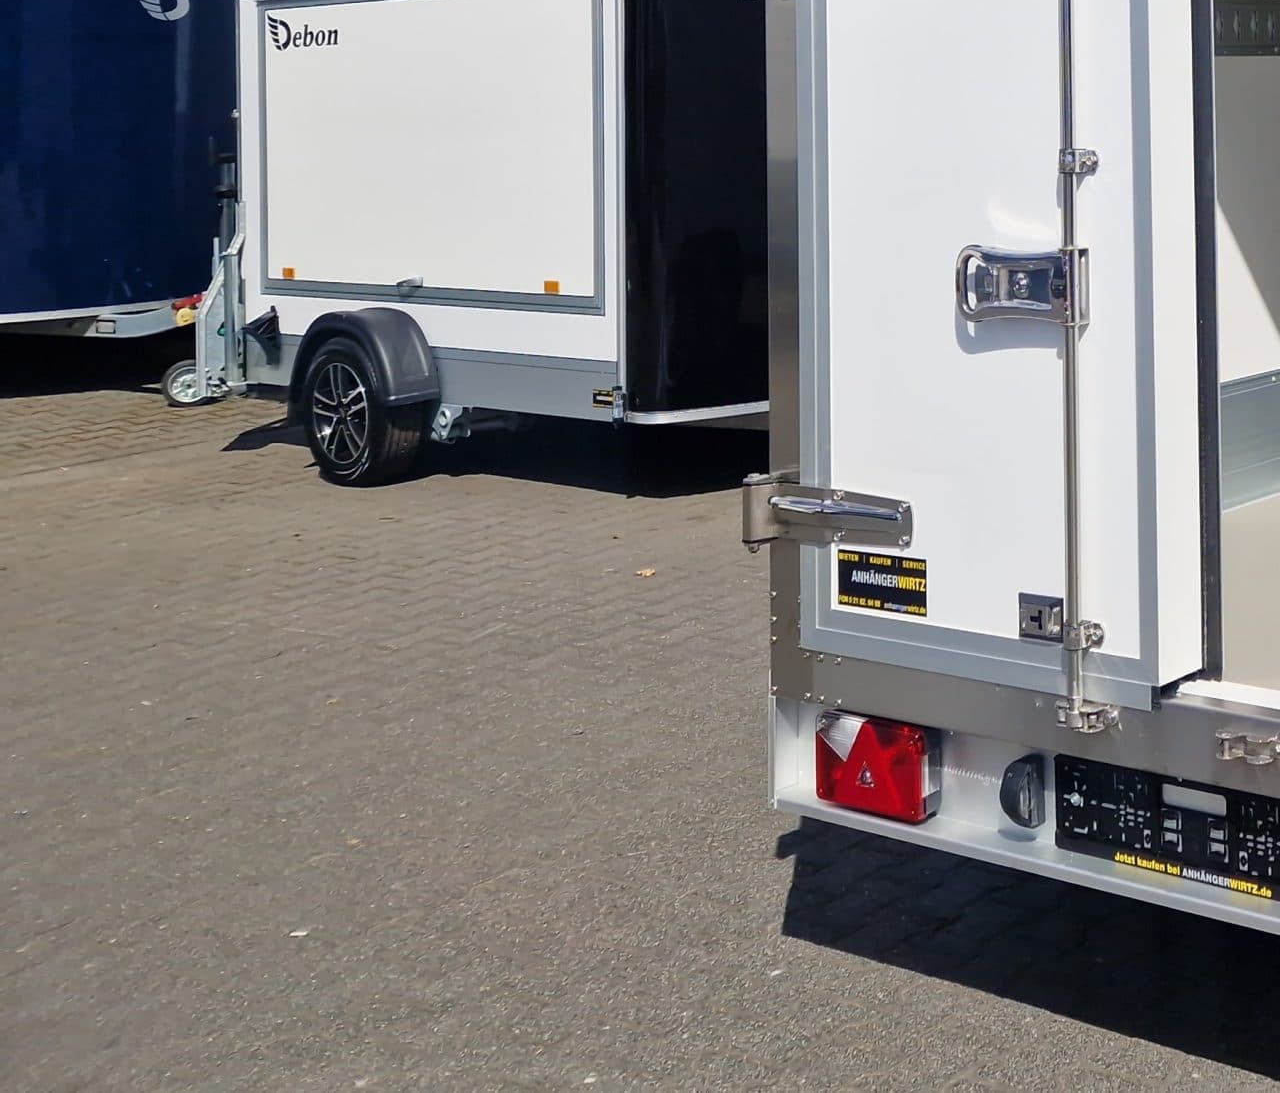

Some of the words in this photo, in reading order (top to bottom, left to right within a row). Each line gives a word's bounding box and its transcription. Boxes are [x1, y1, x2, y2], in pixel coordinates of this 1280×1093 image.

[266, 12, 339, 51] Debon
[869, 556, 892, 566] KAUFEN
[902, 560, 926, 571] SERVICE
[851, 569, 926, 592] ANHÄNGERWIRTZ
[1114, 851, 1136, 865] Jetzt
[1137, 857, 1166, 872] kaufen
[1167, 862, 1181, 875] bei
[1182, 867, 1272, 898] ANHÄNGERWIRTZ.de
